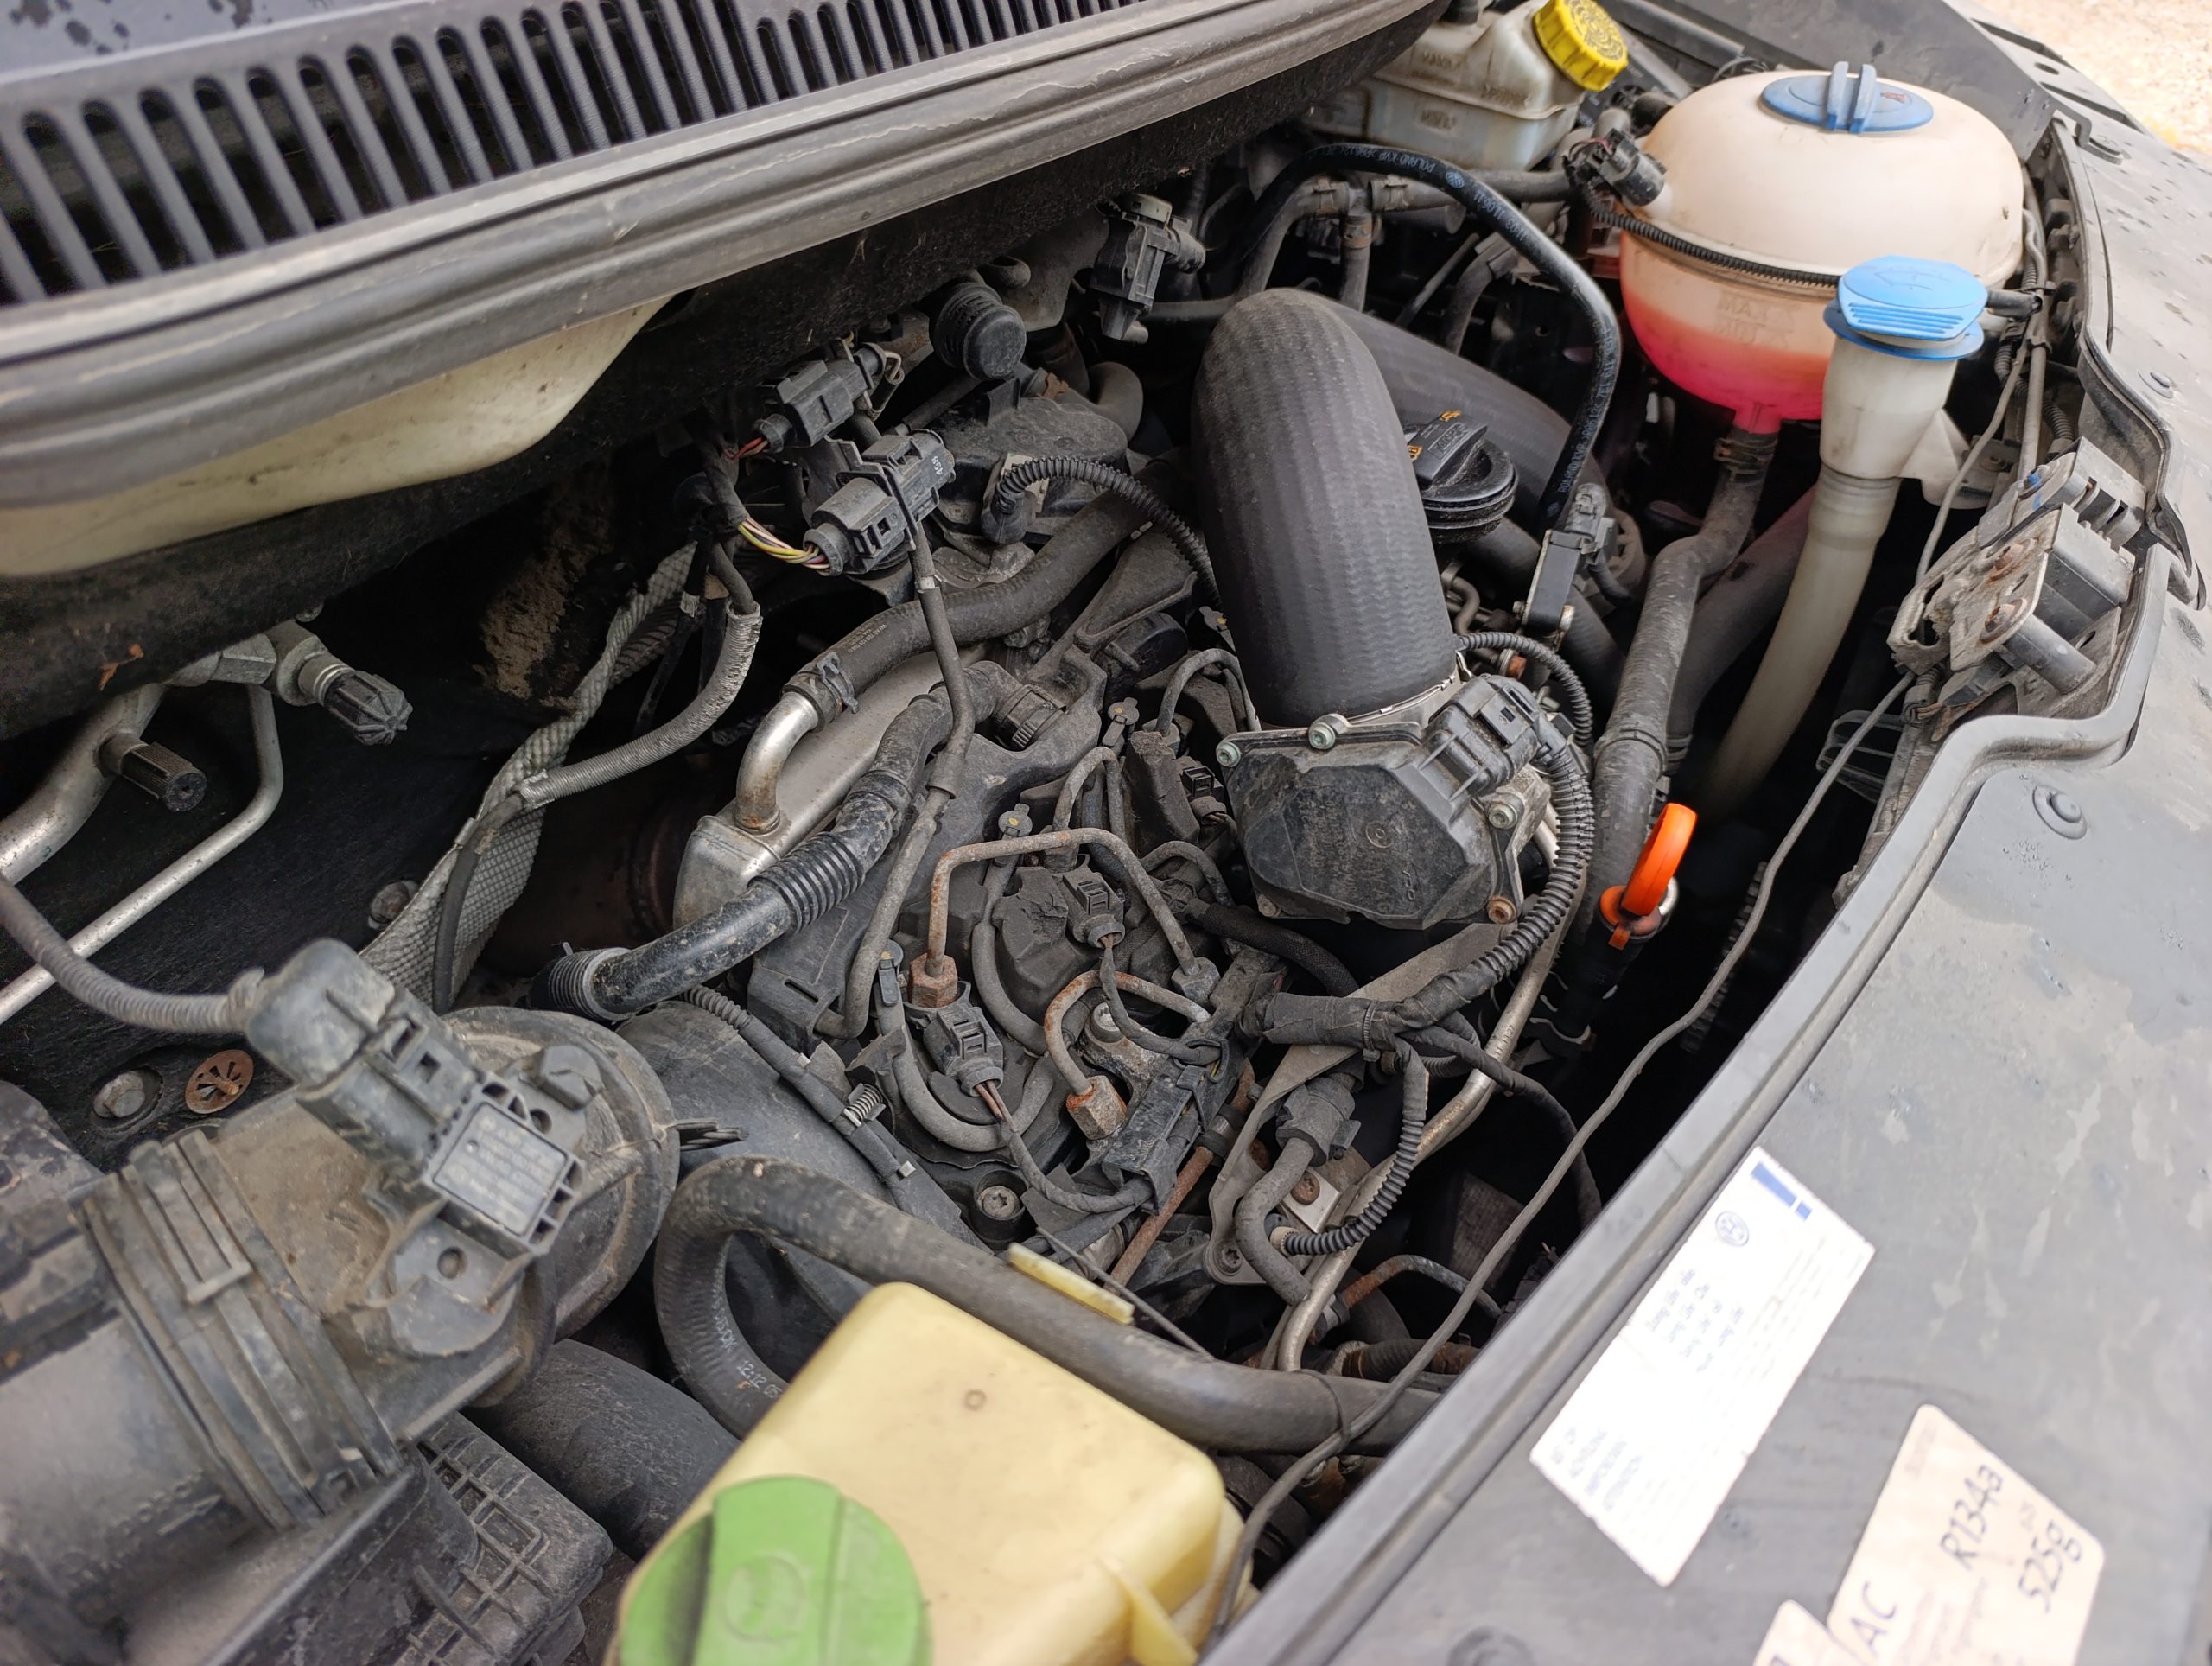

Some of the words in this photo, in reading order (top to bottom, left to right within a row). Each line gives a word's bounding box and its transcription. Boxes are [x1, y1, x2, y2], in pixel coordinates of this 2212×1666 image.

[1939, 1464, 2005, 1571] R134a
[2017, 1518, 2083, 1613] 525g
[1849, 1580, 1898, 1658] AC
